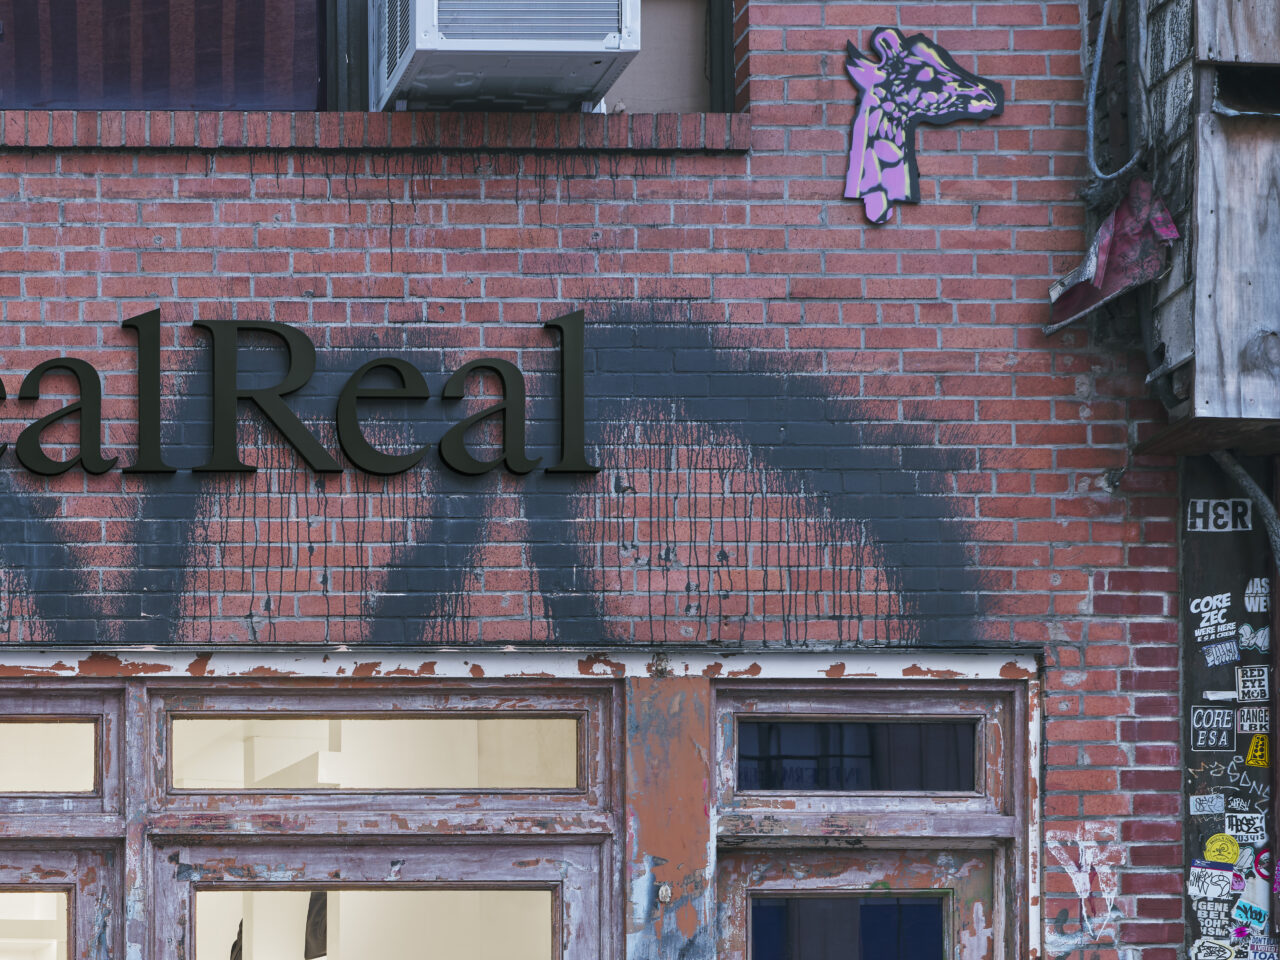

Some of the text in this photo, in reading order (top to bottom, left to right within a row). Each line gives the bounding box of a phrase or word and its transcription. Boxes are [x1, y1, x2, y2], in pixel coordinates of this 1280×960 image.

[1190, 592, 1231, 613] CORE
[1200, 609, 1227, 628] ZEC
[1195, 622, 1236, 637] WERE HERE
[1241, 669, 1265, 678] RED
[1242, 679, 1265, 688] EYE
[1194, 709, 1233, 728] CORE
[1240, 709, 1269, 723] RANGE
